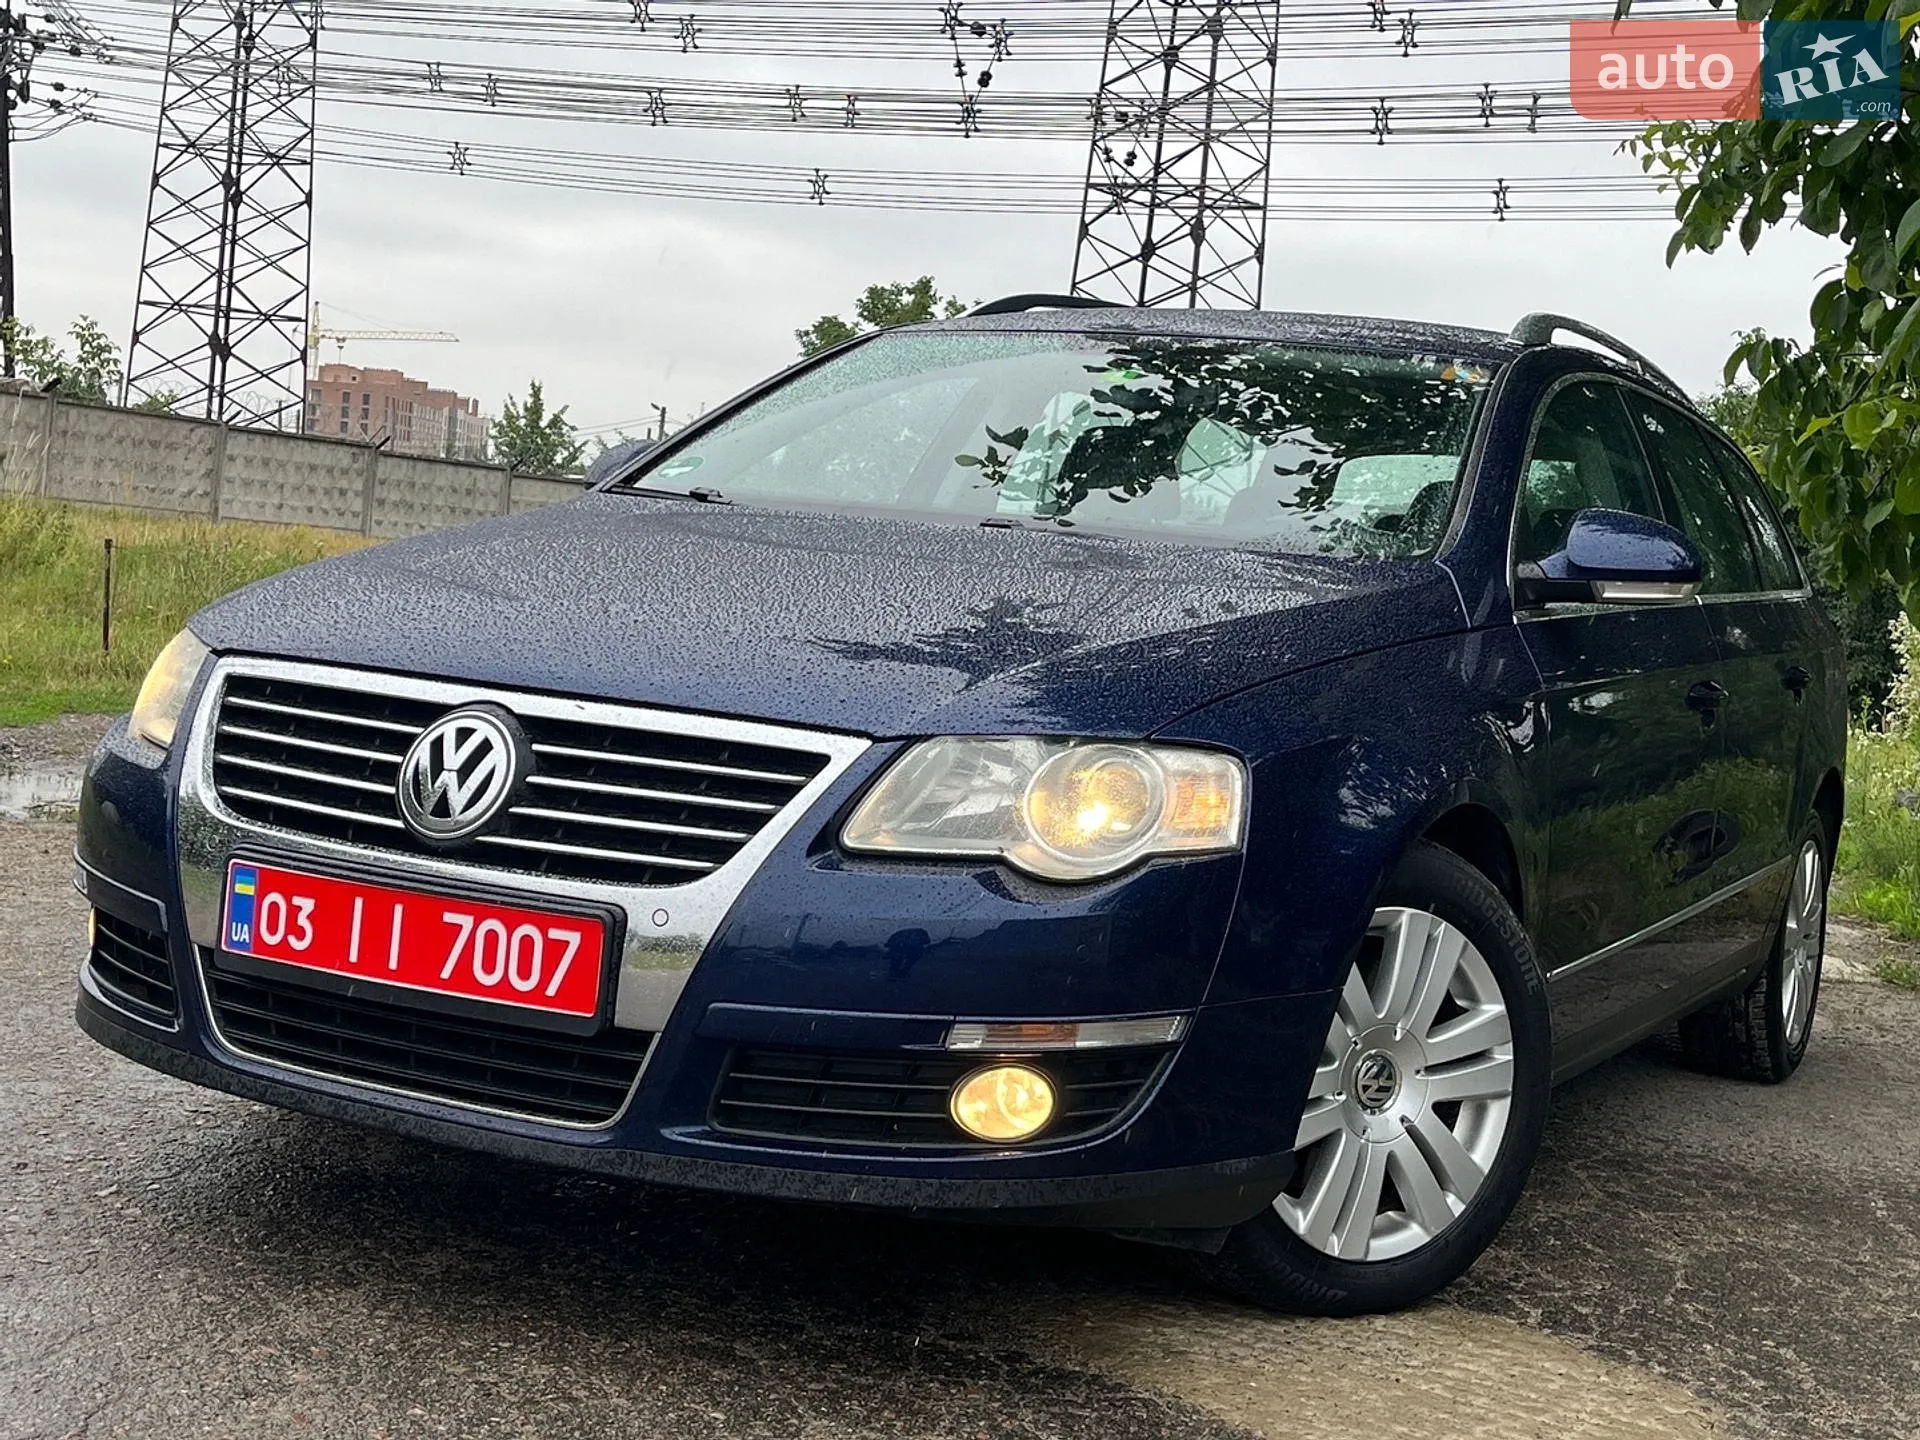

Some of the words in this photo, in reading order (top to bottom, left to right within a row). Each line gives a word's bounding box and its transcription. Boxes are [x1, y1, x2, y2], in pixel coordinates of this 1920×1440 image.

[231, 921, 251, 945] UA
[258, 891, 316, 952] 03
[438, 911, 583, 998] 7007
